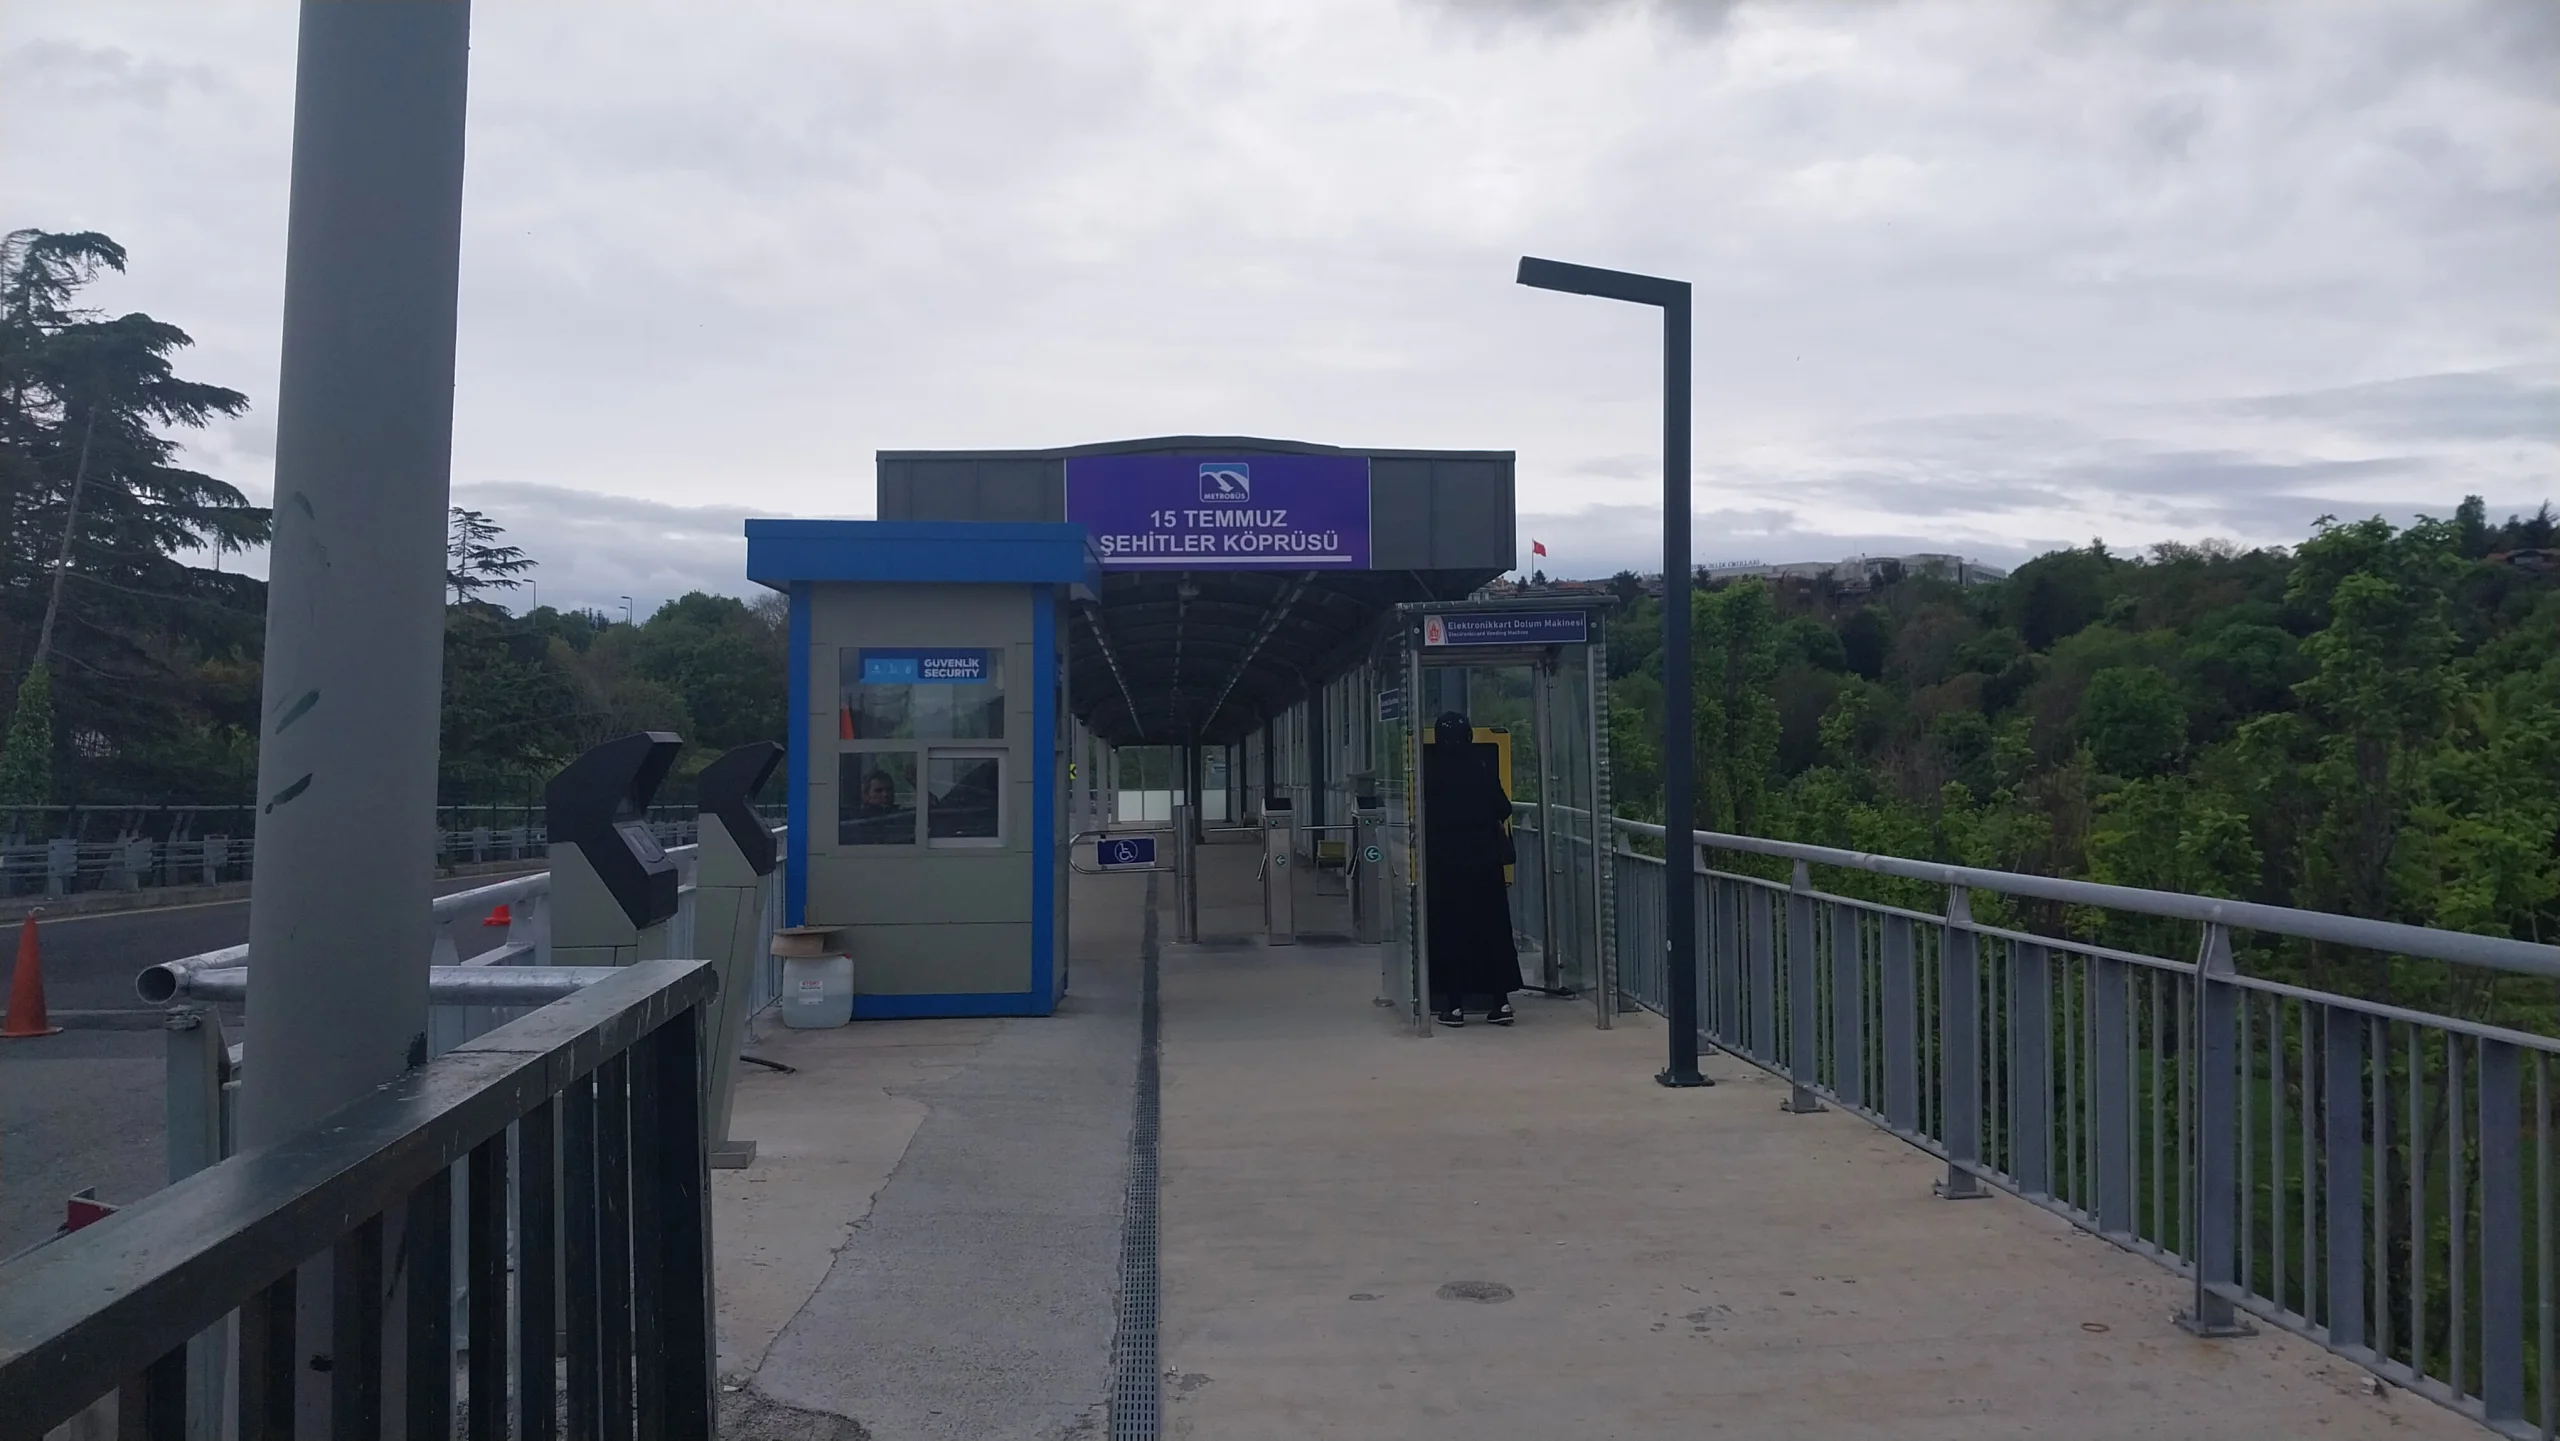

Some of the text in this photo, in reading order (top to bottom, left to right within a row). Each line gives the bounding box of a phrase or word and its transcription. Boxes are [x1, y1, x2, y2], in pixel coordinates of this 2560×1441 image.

[1203, 492, 1246, 500] METROBÜS
[1150, 510, 1287, 528] 15 TEMMUZ
[1100, 530, 1338, 556] ŞEHİTLER KÖPRÜSÜ
[1448, 618, 1583, 630] Elektronikkart Dolum Makinesi
[924, 668, 979, 677] SECURITY
